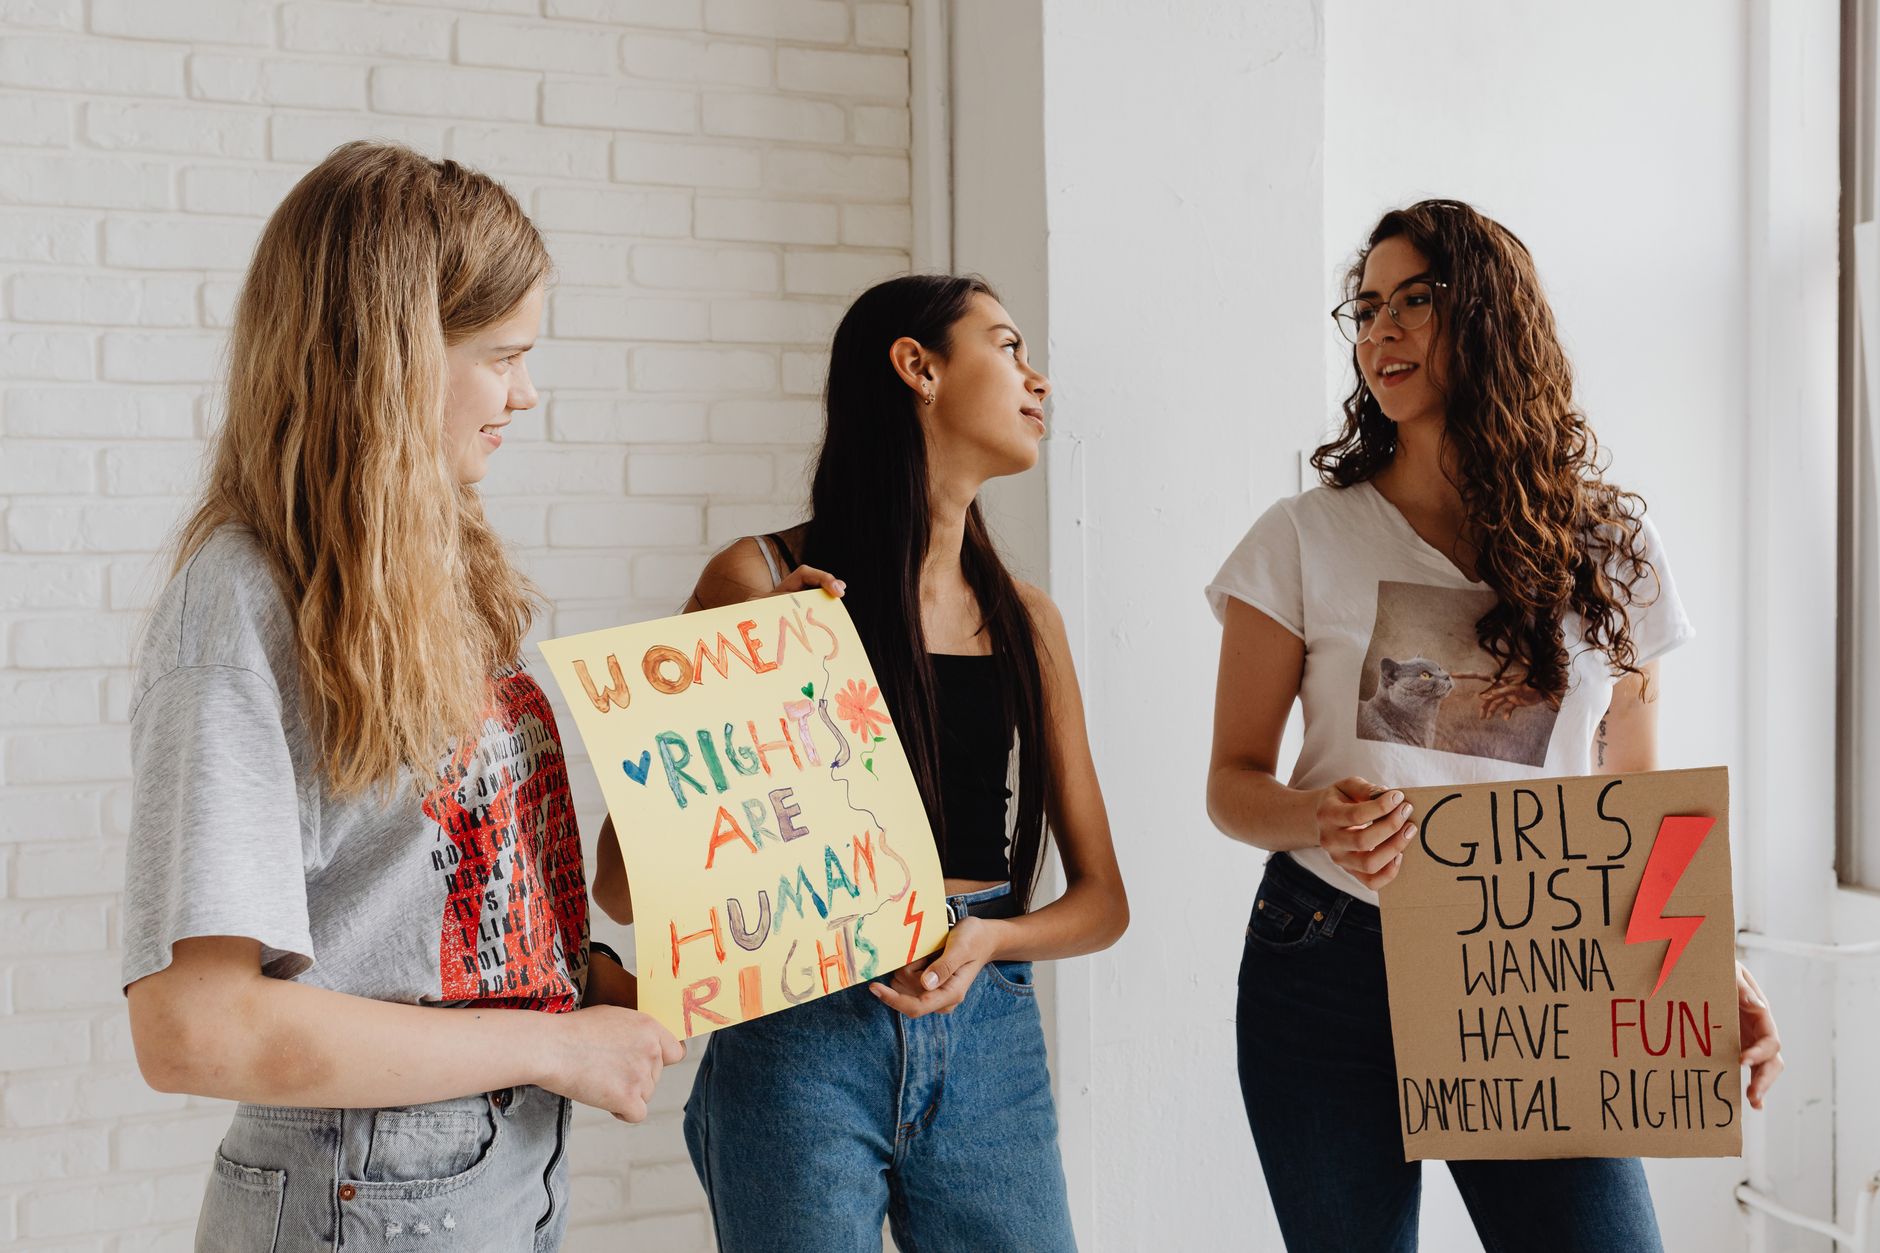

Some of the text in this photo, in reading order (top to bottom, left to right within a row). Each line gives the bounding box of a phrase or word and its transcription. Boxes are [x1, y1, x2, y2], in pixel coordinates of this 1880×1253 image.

[655, 698, 851, 808] RIGHTS
[447, 803, 497, 836] LIKE
[705, 787, 810, 870] ARE
[1420, 780, 1633, 867] GIRLS
[431, 837, 484, 871] ROLL
[445, 859, 504, 895] ROCK
[452, 889, 499, 921] IT'S
[461, 926, 471, 948] I
[479, 908, 525, 942] LIKE
[1456, 864, 1625, 936] JUST
[462, 942, 516, 975] ROLL
[479, 964, 531, 998] ROCK
[681, 913, 879, 1038] RIGHTS
[1462, 938, 1615, 996] WANNA
[1458, 998, 1722, 1062] HAVE FUN-
[1403, 1069, 1734, 1134] DAMENTAL RIGHTS
